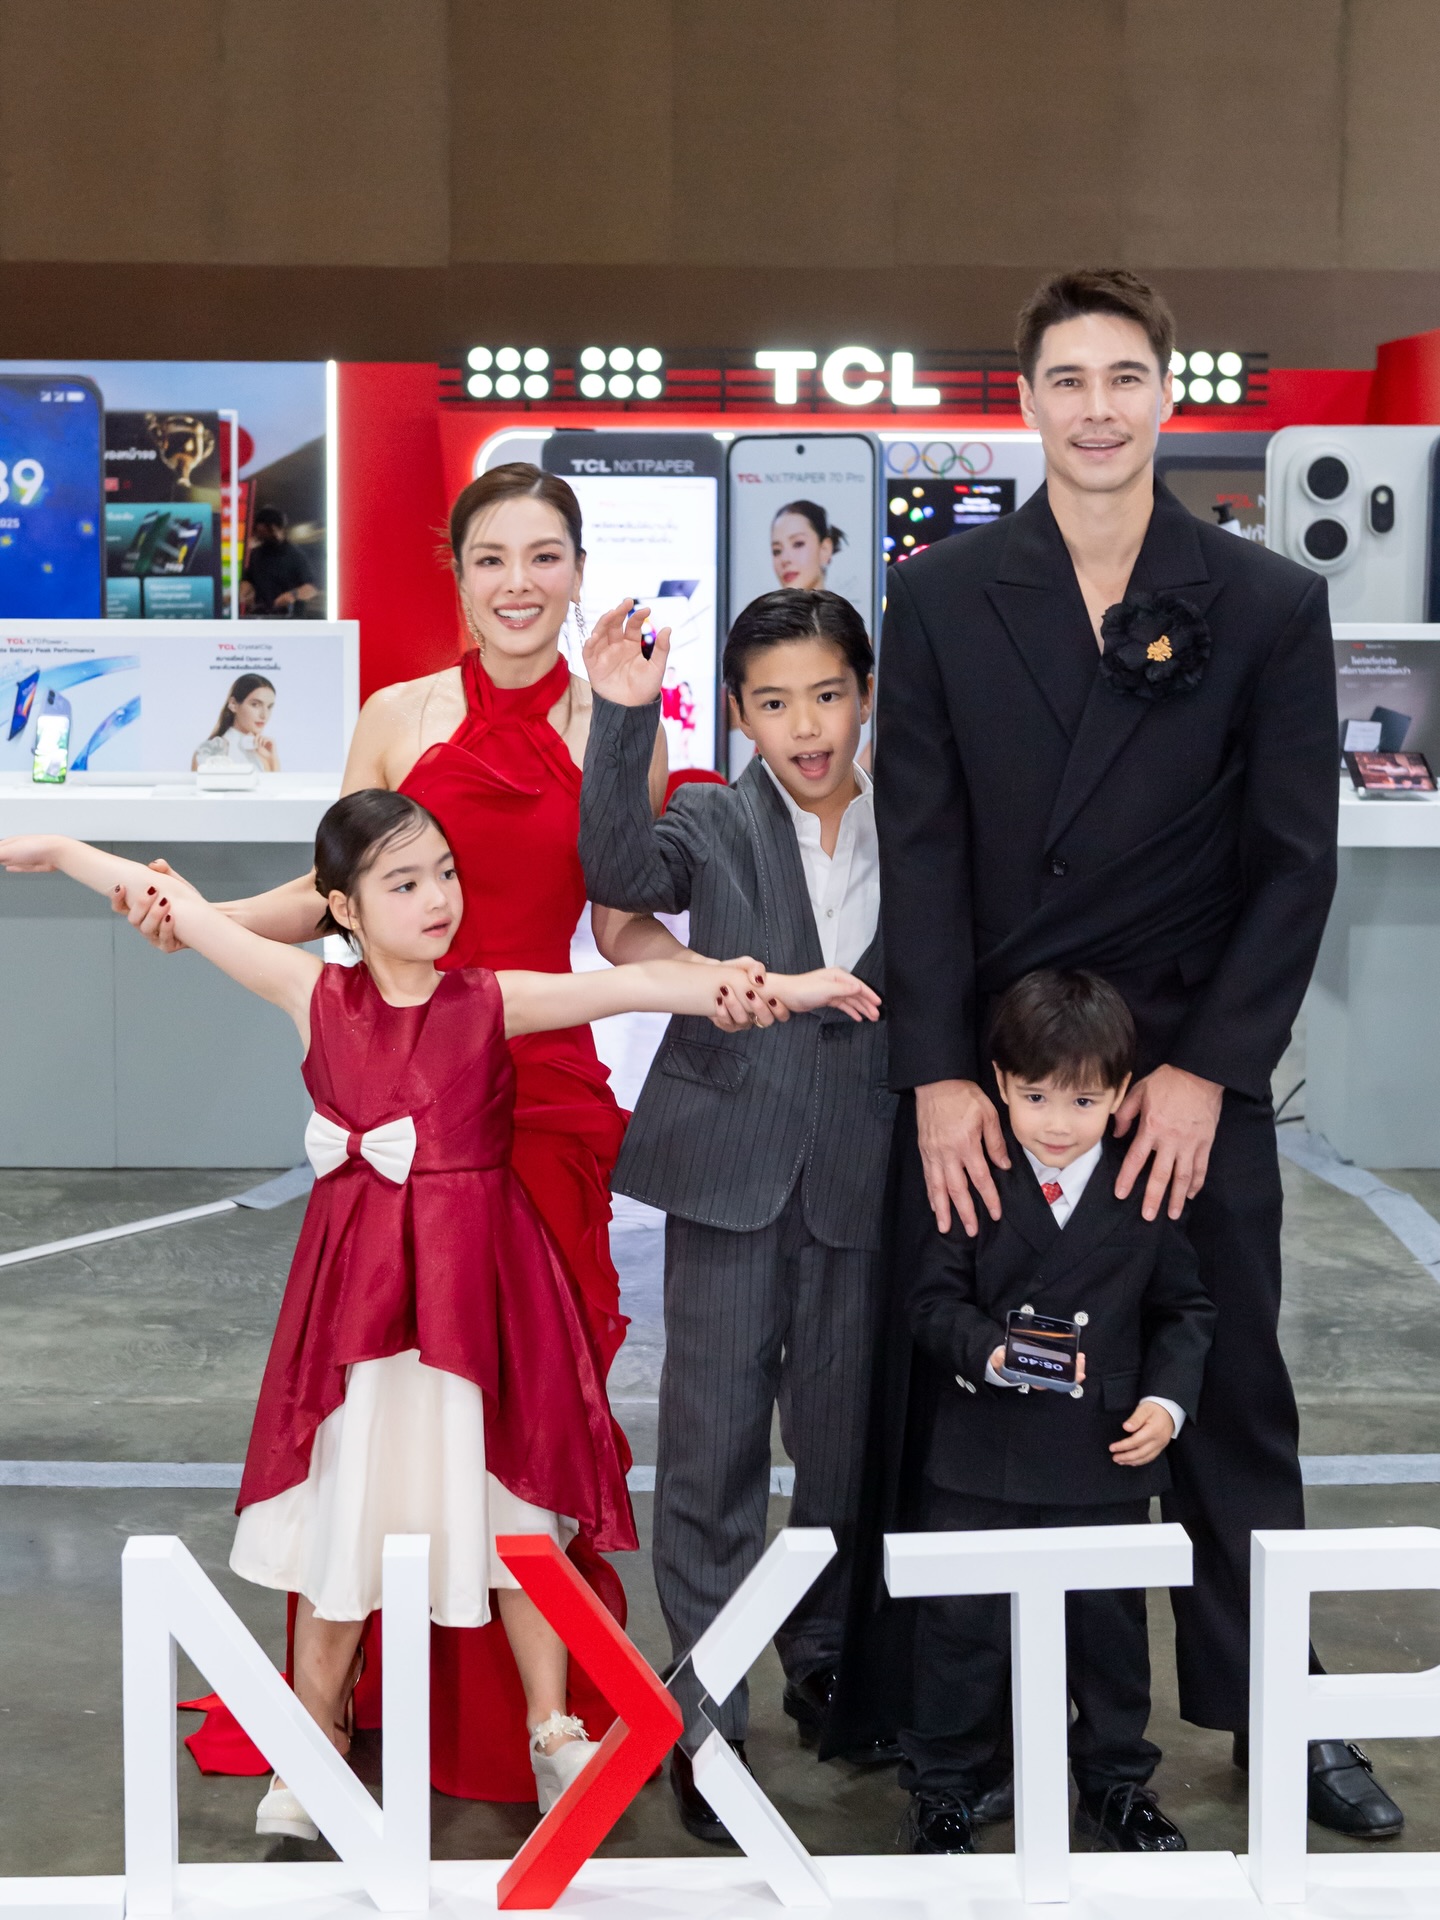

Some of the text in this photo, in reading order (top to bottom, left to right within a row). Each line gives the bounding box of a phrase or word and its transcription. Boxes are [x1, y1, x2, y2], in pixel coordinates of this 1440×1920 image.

[755, 347, 941, 406] TCL
[570, 459, 695, 473] TCL NXTPAPER
[737, 472, 865, 484] TCL NXTPAPER 70 Pro
